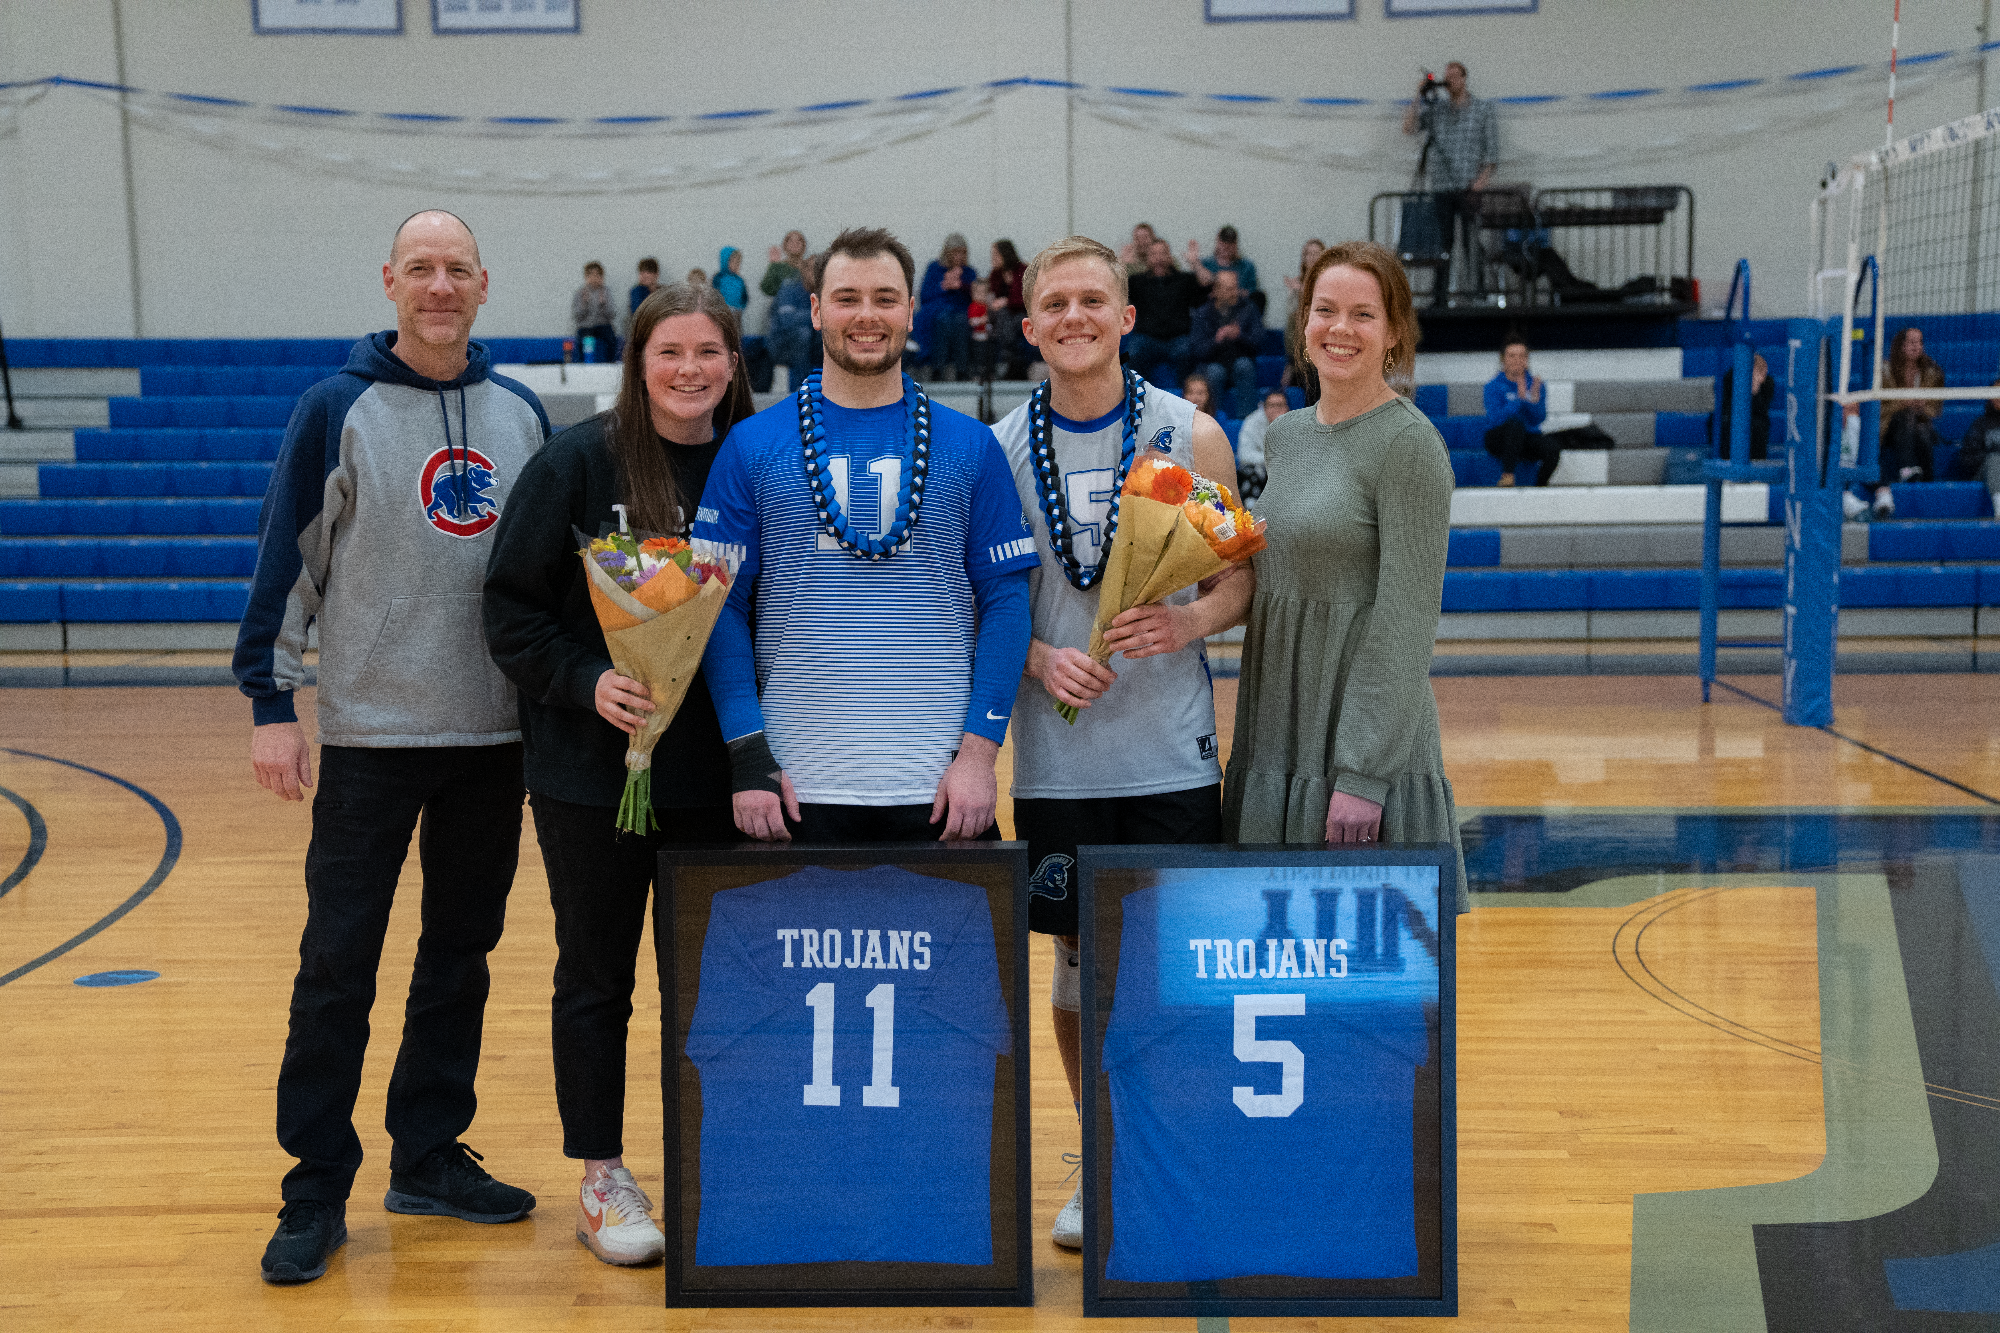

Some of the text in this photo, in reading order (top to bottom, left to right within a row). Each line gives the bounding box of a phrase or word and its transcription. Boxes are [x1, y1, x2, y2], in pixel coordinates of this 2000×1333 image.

[814, 454, 914, 554] 11
[1064, 467, 1116, 570] 5
[776, 928, 932, 970] TROJANS
[1189, 938, 1348, 979] TROJANS
[803, 982, 900, 1107] 11
[1232, 993, 1306, 1117] 5
